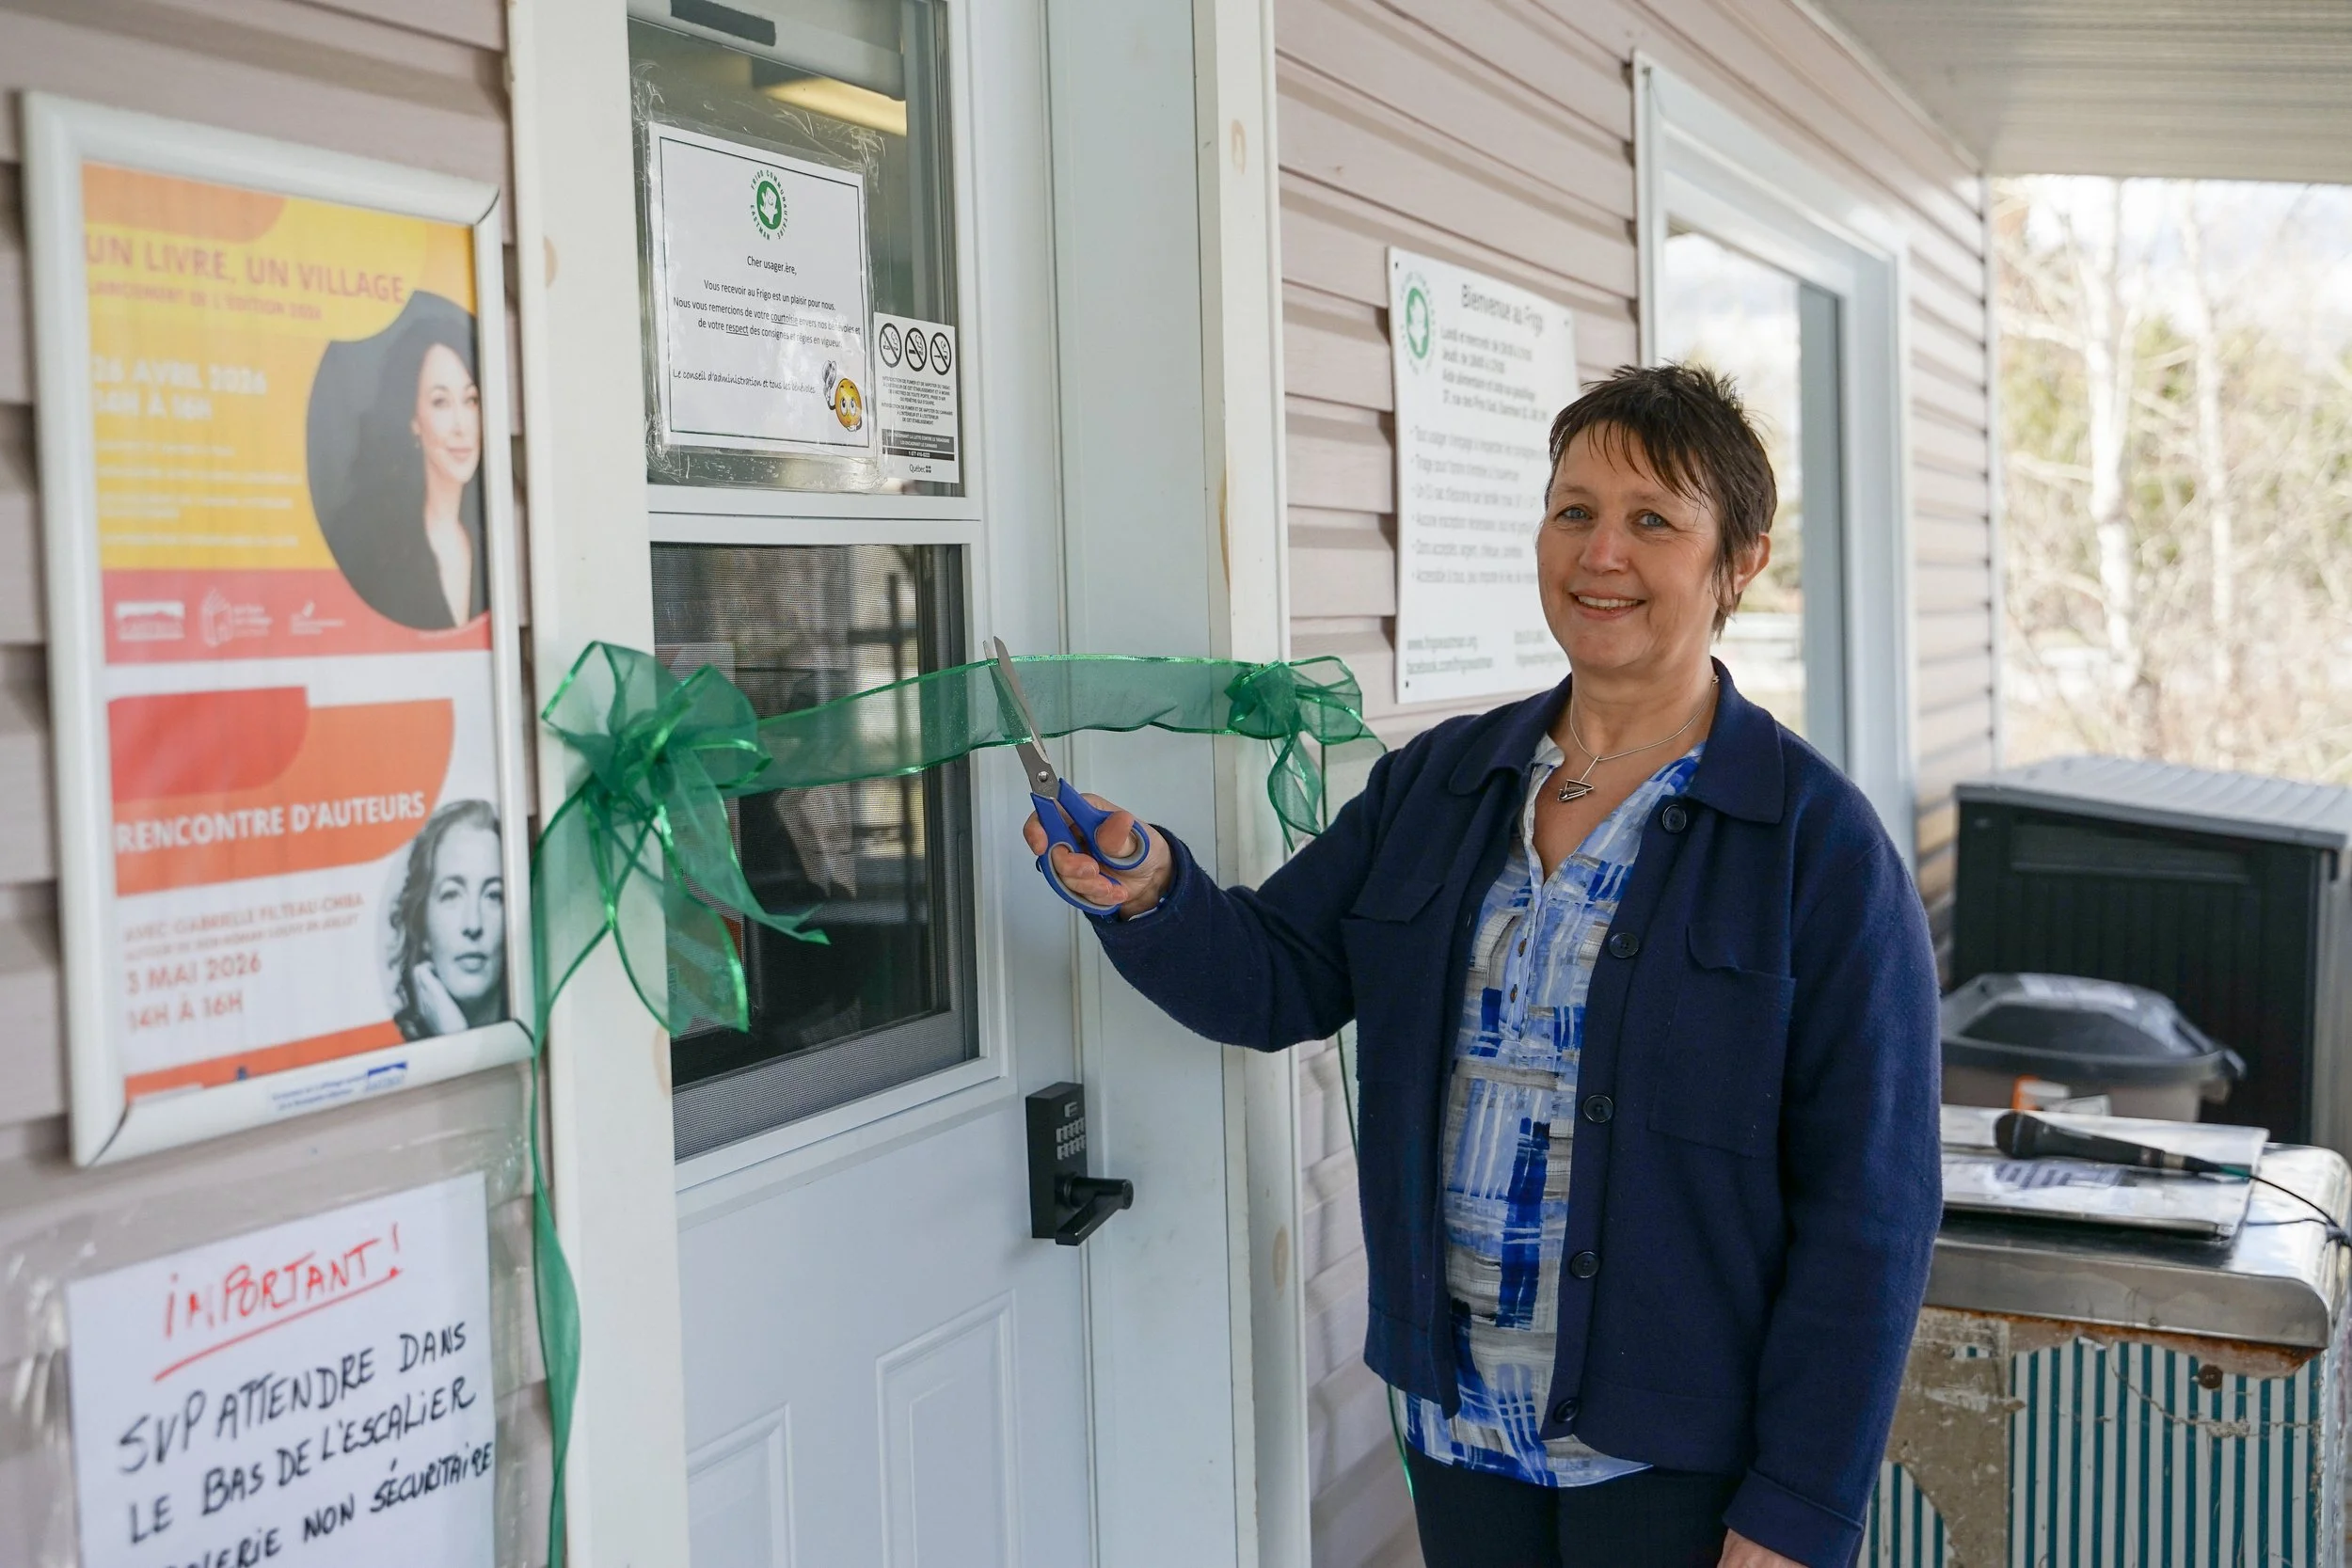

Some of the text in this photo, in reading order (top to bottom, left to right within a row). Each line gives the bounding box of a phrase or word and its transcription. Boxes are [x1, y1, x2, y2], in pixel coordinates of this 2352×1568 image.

[144, 240, 236, 286] LIVRE,
[246, 255, 289, 288] UN
[296, 261, 405, 305] VILLAGE
[746, 255, 762, 268] Cher
[673, 295, 691, 309] Nous
[691, 300, 707, 311] vous
[708, 303, 744, 317] remercions
[744, 307, 753, 318] de
[753, 309, 771, 321] votre
[771, 311, 799, 325] courtoisie
[704, 278, 836, 311] Vous recevoir au Frigo est un plaisir pour nous.
[698, 317, 707, 328] de
[707, 320, 725, 331] votre
[725, 323, 749, 336] respect
[750, 325, 761, 337] des
[761, 329, 790, 341] consignes
[813, 337, 821, 345] en
[673, 368, 682, 378] Le
[682, 369, 707, 381] conseil
[707, 371, 762, 388] d'administration
[762, 379, 769, 388] et
[909, 464, 925, 473] Québec
[114, 791, 426, 852] RENCONTRE D'AUTEURS
[149, 962, 199, 993] MAI
[206, 950, 263, 983] 2026
[203, 990, 245, 1020] 16H
[116, 1321, 469, 1476] SVP ATTENDRE DANS
[129, 1494, 173, 1545] LE
[200, 1465, 266, 1517] BAS
[276, 1438, 312, 1488] DE
[302, 1492, 356, 1544] NON
